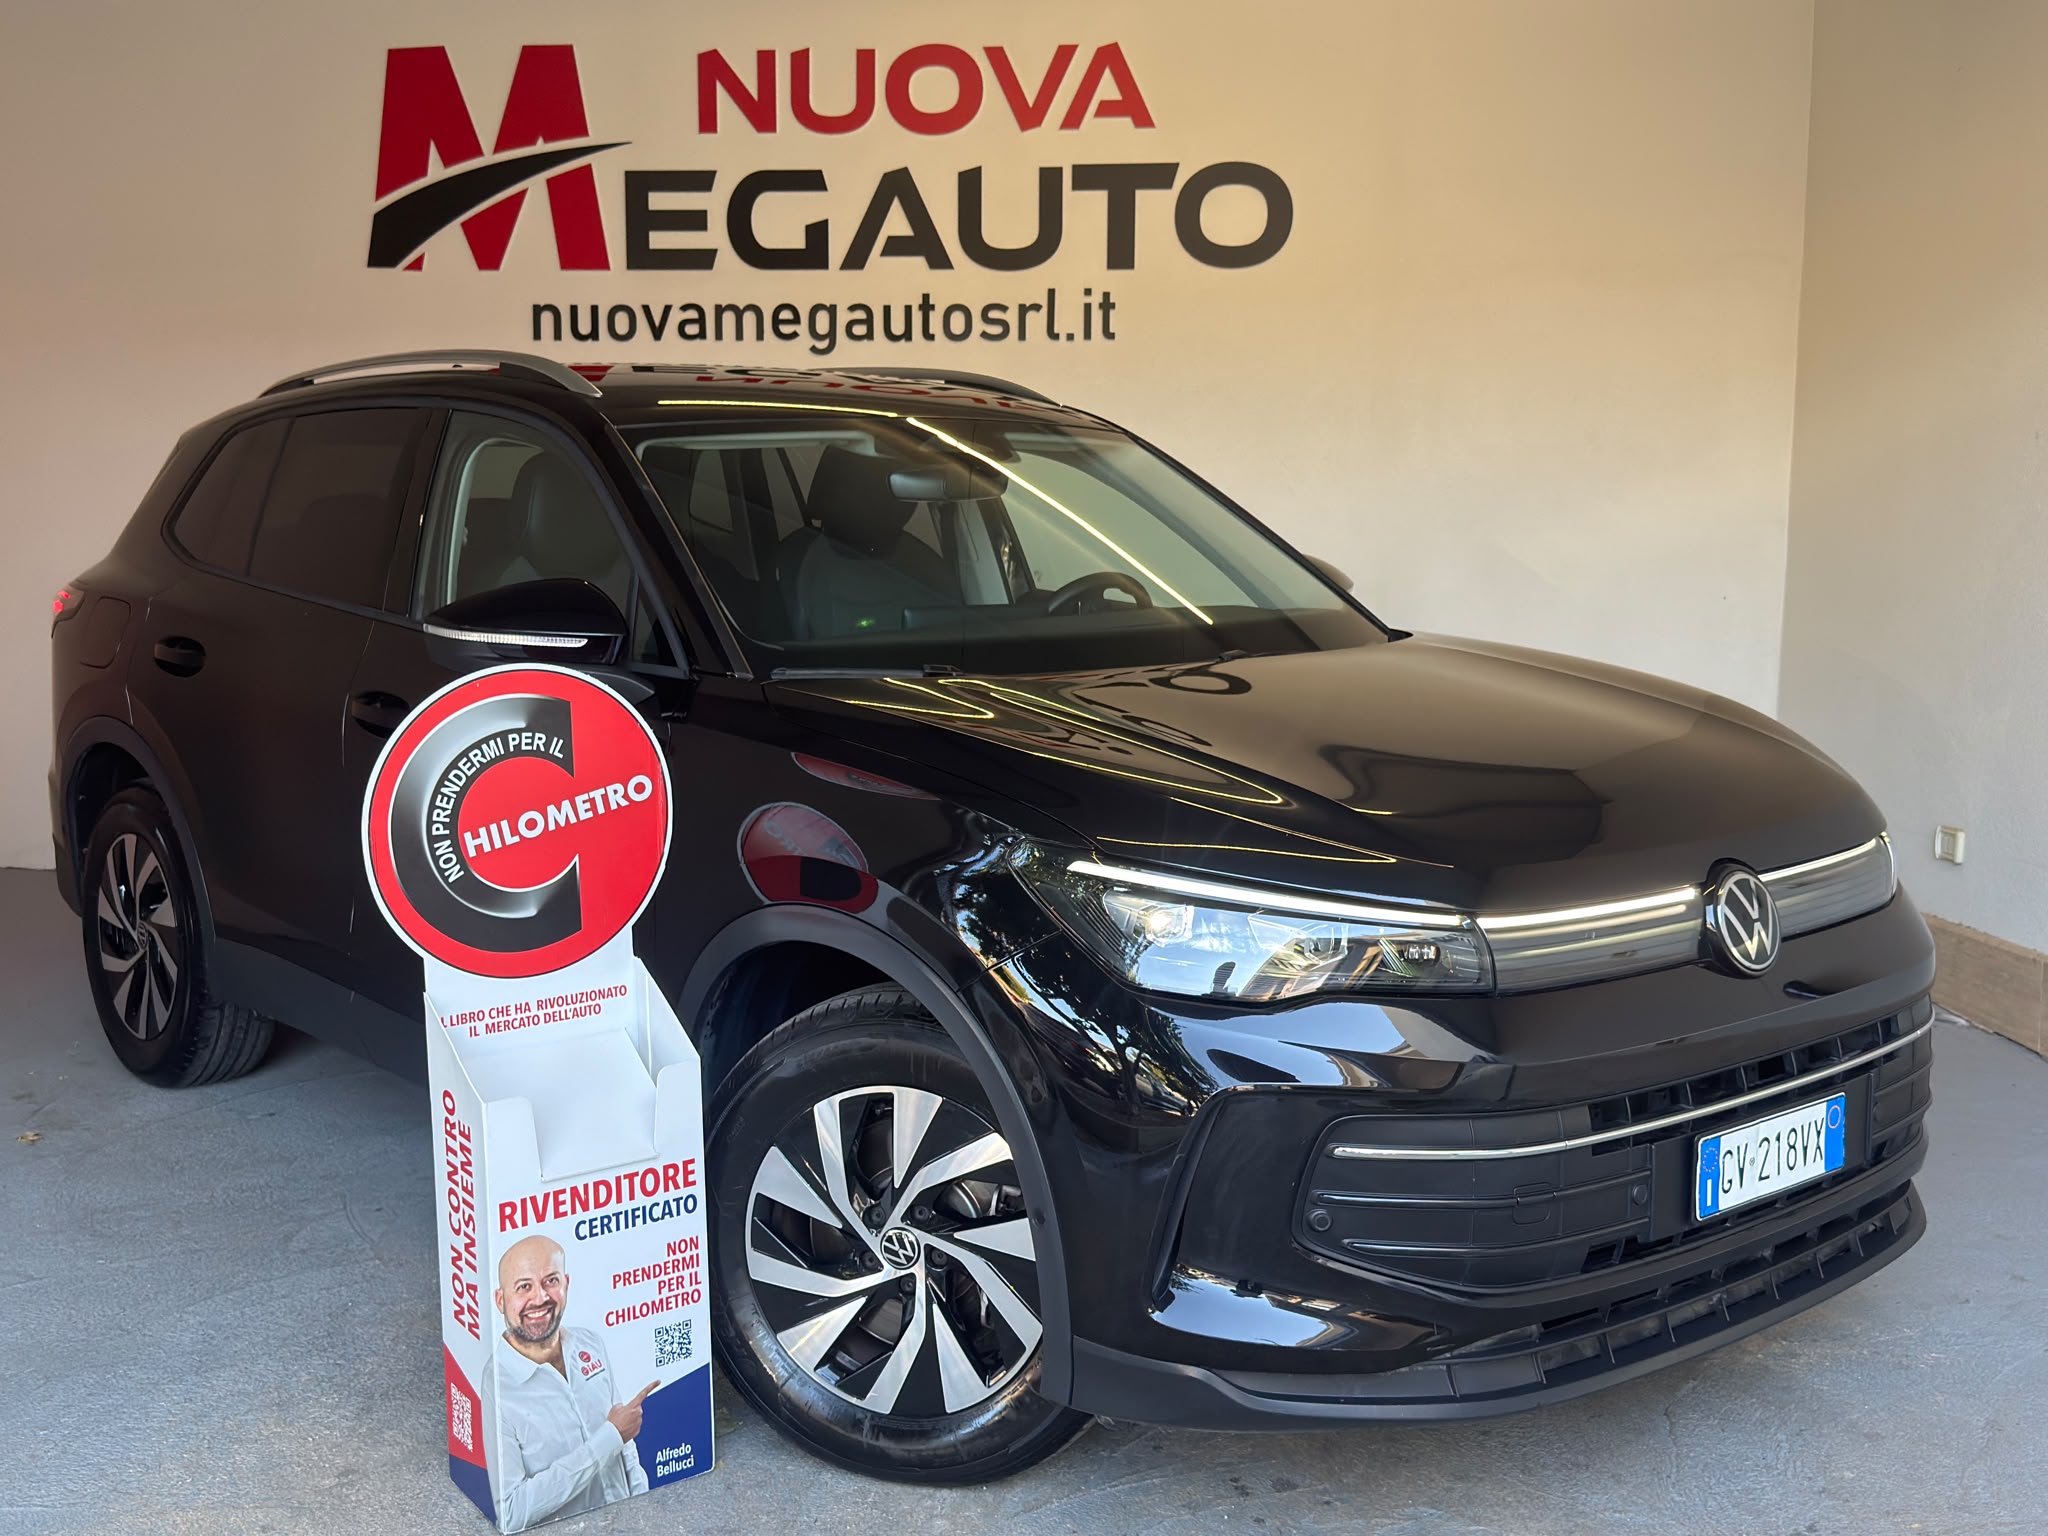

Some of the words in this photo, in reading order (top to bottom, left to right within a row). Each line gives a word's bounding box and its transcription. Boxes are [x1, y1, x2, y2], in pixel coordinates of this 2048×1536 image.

[698, 42, 1156, 135] NUOVA
[367, 44, 1293, 271] MEGAUTO
[532, 287, 1116, 356] nuovamegautosrl.it
[507, 732, 547, 752] PER
[549, 736, 564, 759] IL
[432, 737, 505, 837] PRENDERMI
[463, 774, 653, 858] HILOMETRO
[433, 839, 465, 883] NON
[449, 1010, 486, 1027] LIBRO
[487, 1005, 512, 1020] CHE
[514, 1001, 532, 1015] HA
[536, 985, 628, 1011] RIVOLUZIONATO
[469, 1025, 480, 1038] IL
[485, 1013, 541, 1035] MERCATO
[543, 1003, 602, 1025] DELL'AUTO
[443, 1089, 462, 1237] CONTRO
[1721, 1143, 1749, 1194] GV
[1758, 1117, 1825, 1182] 218VX
[458, 1119, 477, 1274] INSIEME
[498, 1158, 697, 1233] RIVENDITORE
[575, 1193, 698, 1241] CERTIFICATO
[666, 1235, 700, 1258] NON
[451, 1245, 466, 1328] NON
[612, 1253, 701, 1290] PRENDERMI
[657, 1275, 686, 1295] PER
[688, 1271, 702, 1288] IL
[466, 1283, 480, 1341] MA
[605, 1288, 702, 1328] CHILOMETRO
[656, 1442, 692, 1464] Alfredo
[656, 1454, 695, 1478] Bellucci
